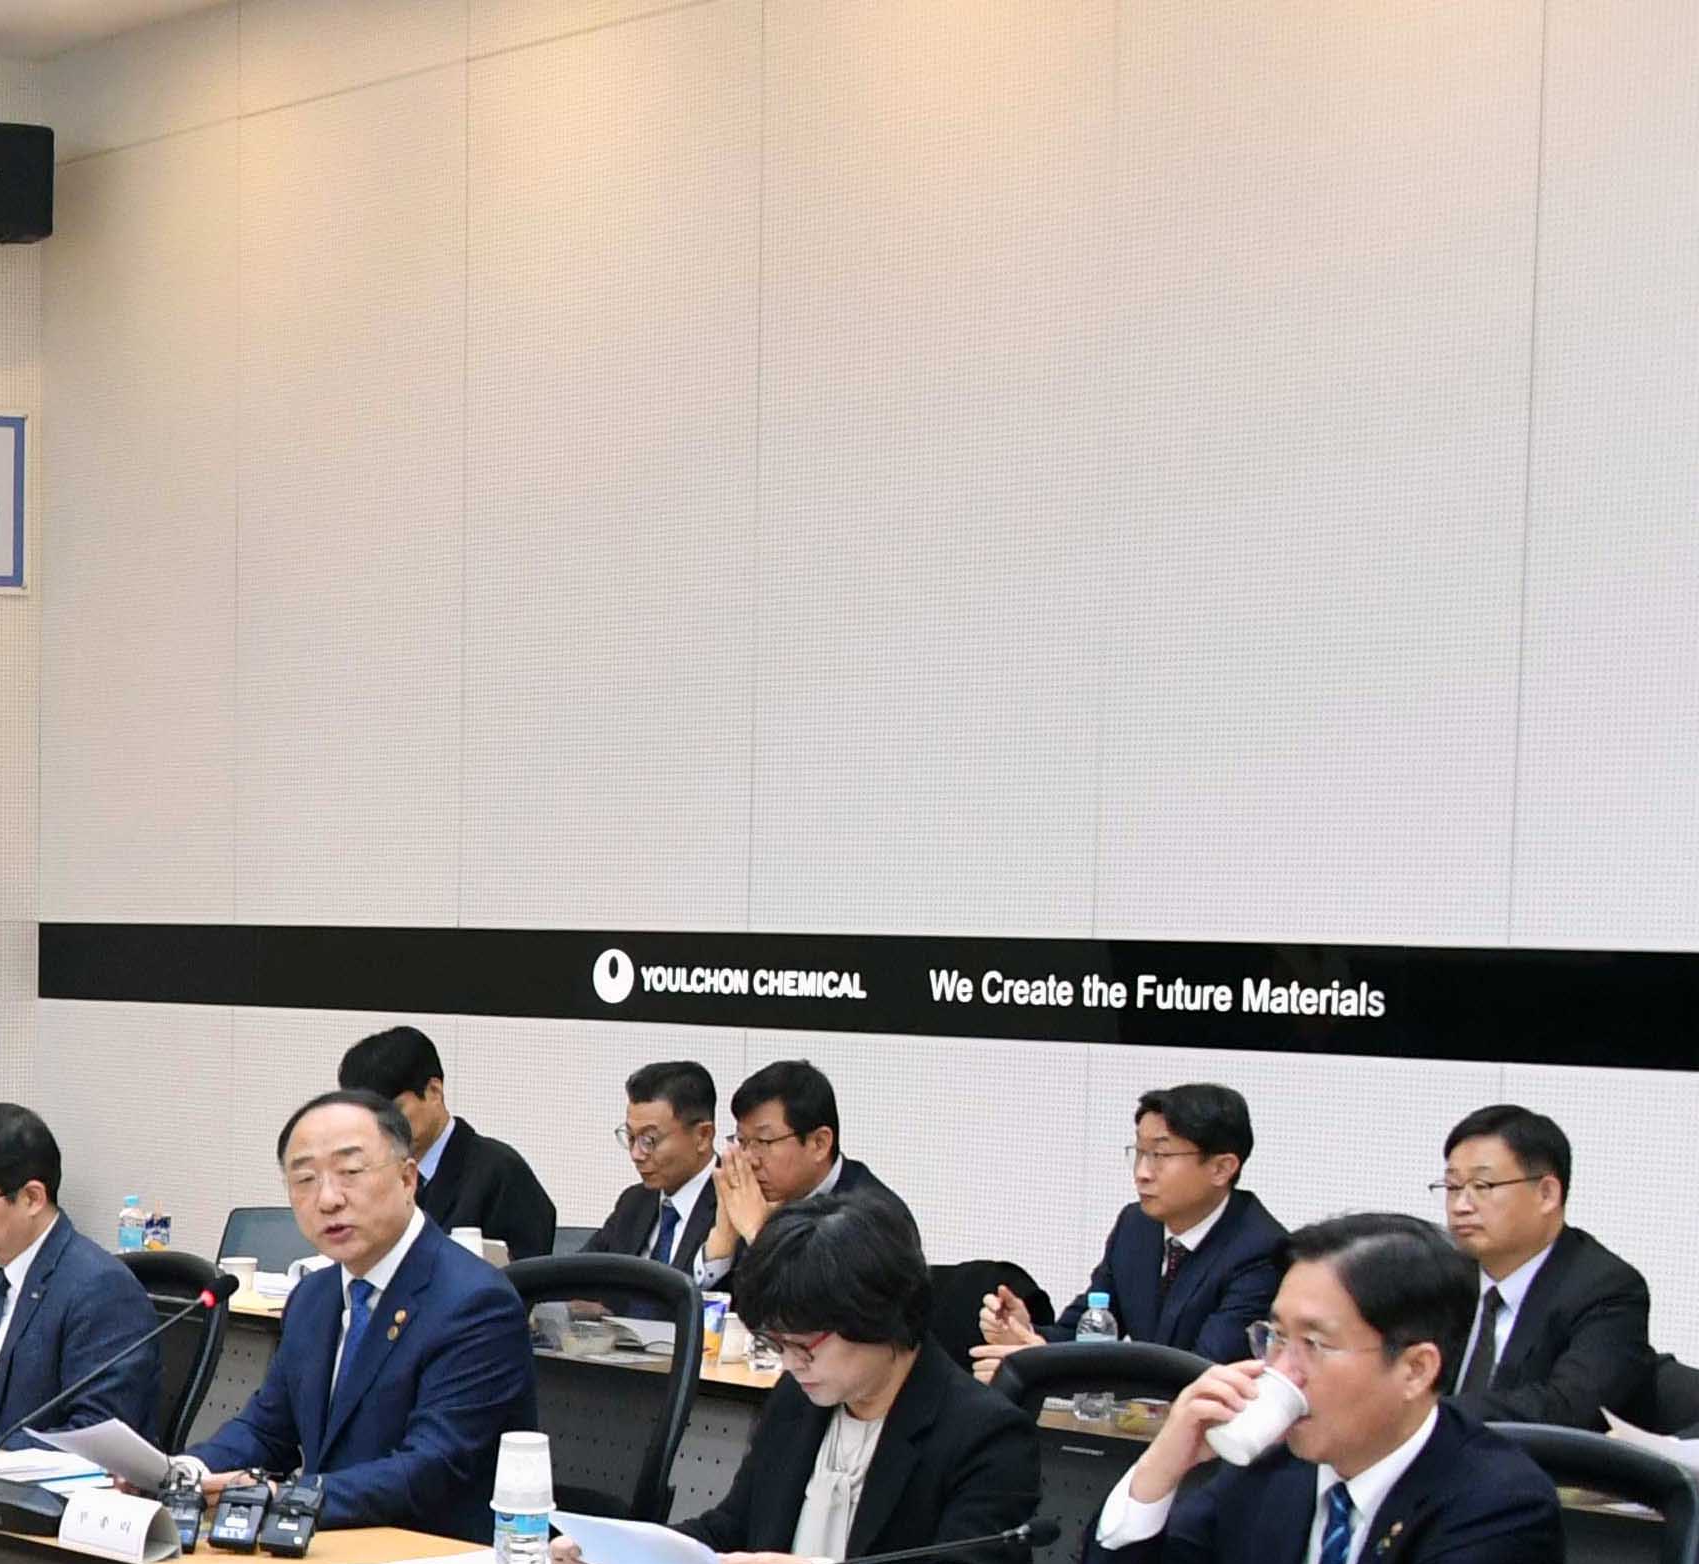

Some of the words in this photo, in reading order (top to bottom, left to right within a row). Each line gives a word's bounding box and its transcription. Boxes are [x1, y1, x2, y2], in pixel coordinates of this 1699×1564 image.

[640, 965, 749, 995] YOULCHON
[752, 968, 868, 999] CHEMICAL
[929, 968, 974, 1003] We
[981, 969, 1075, 1007] Create
[1082, 973, 1128, 1009] the
[1136, 974, 1233, 1012] Future
[1241, 976, 1386, 1017] Materials
